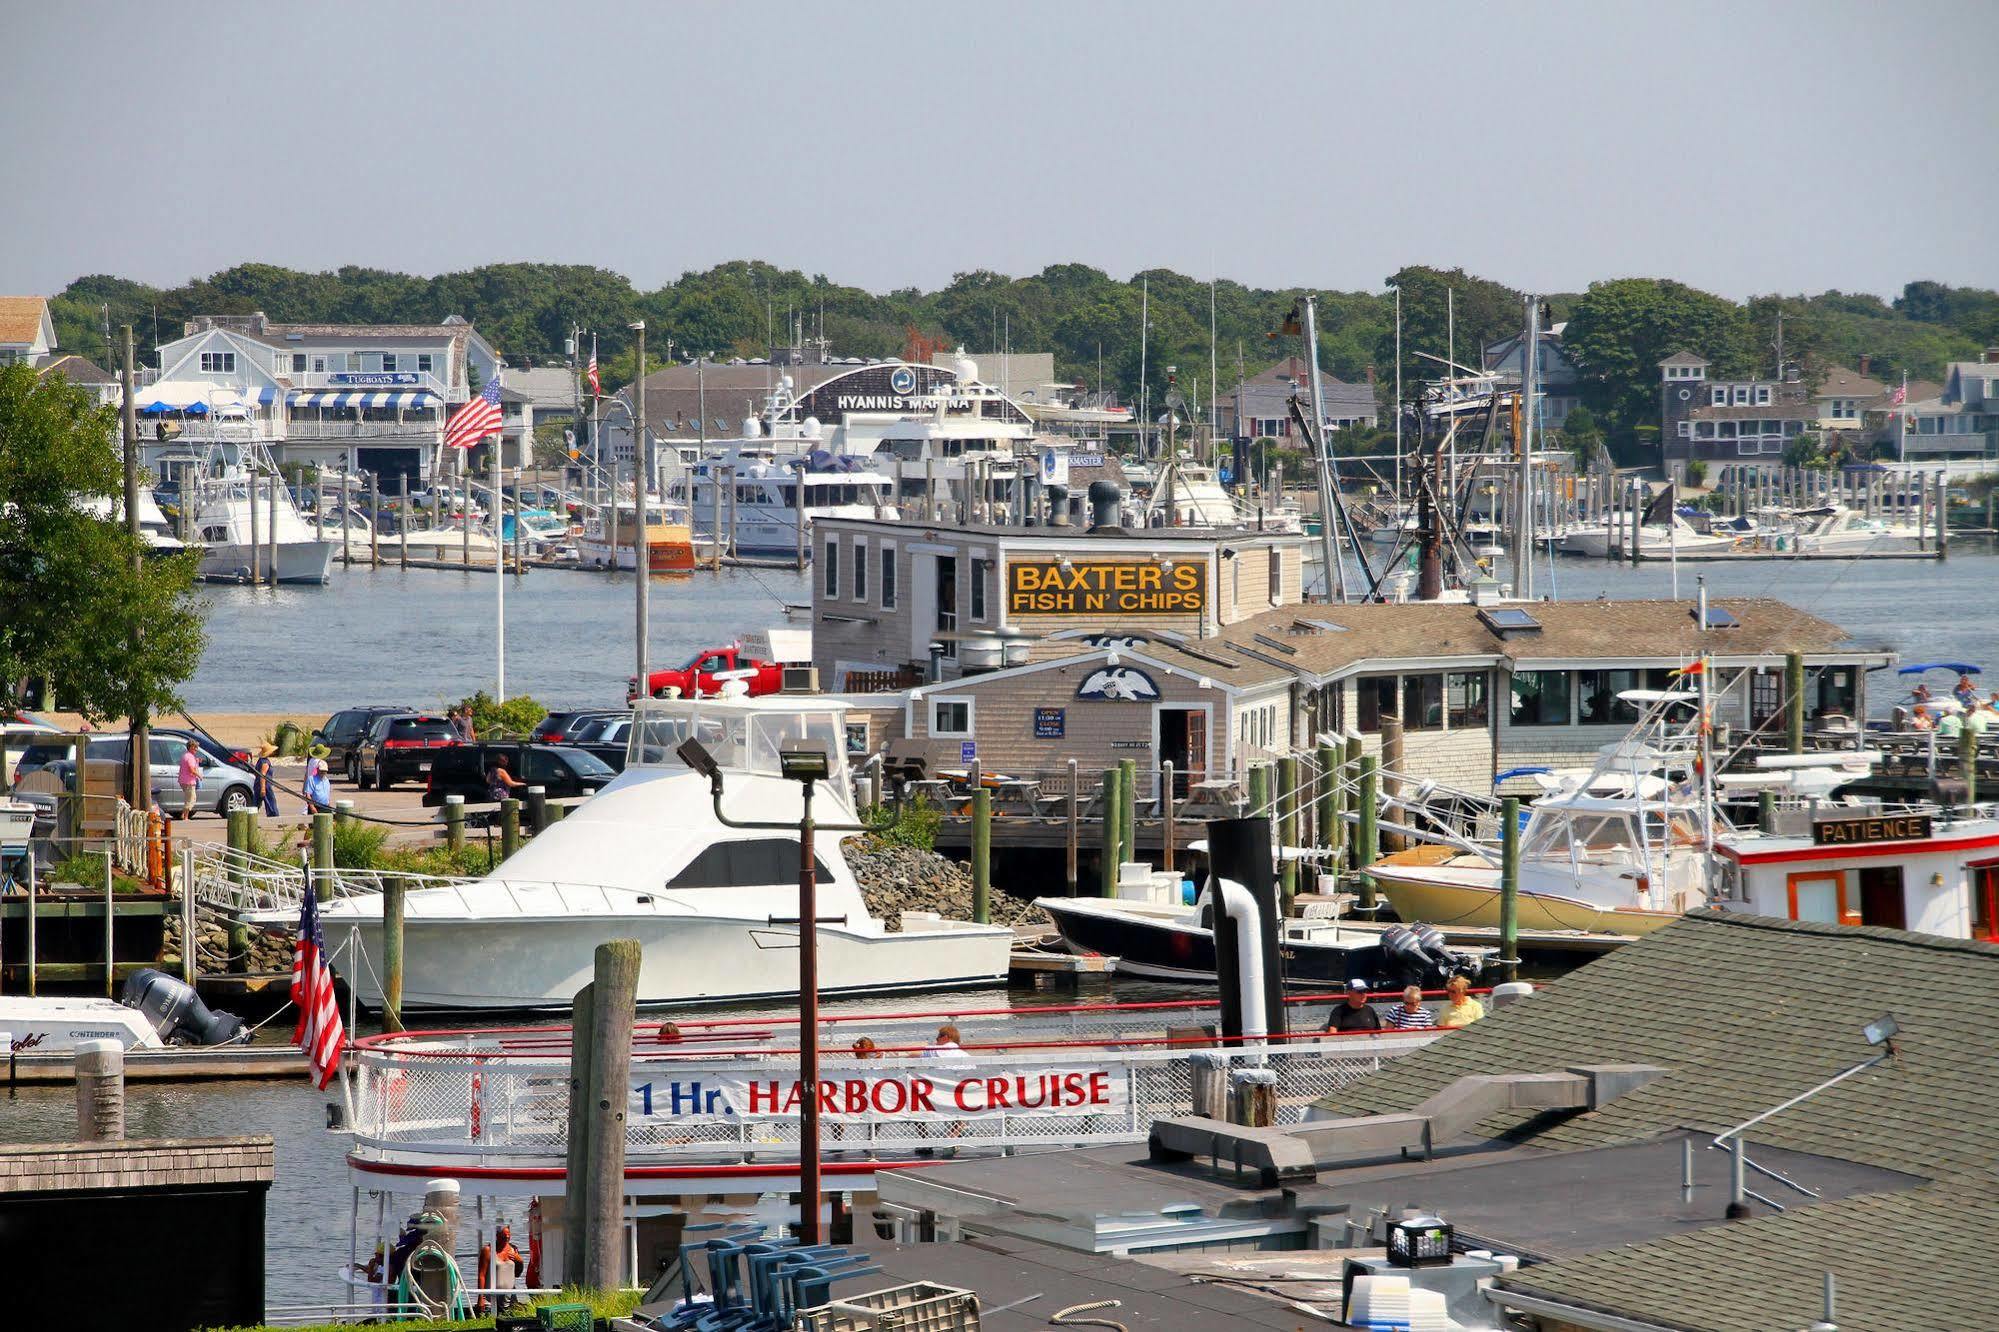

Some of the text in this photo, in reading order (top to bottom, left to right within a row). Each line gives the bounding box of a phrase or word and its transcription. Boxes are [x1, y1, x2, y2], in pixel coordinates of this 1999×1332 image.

[346, 374, 394, 384] TUGBOATS
[838, 396, 903, 409] HYANNIS
[1016, 565, 1198, 591] BAXTER'S
[1013, 592, 1201, 610] FISH N' CHIPS
[1821, 819, 1923, 842] PATIENCE
[634, 1071, 1110, 1116] 1 Hr. HARBOR CRUISE
